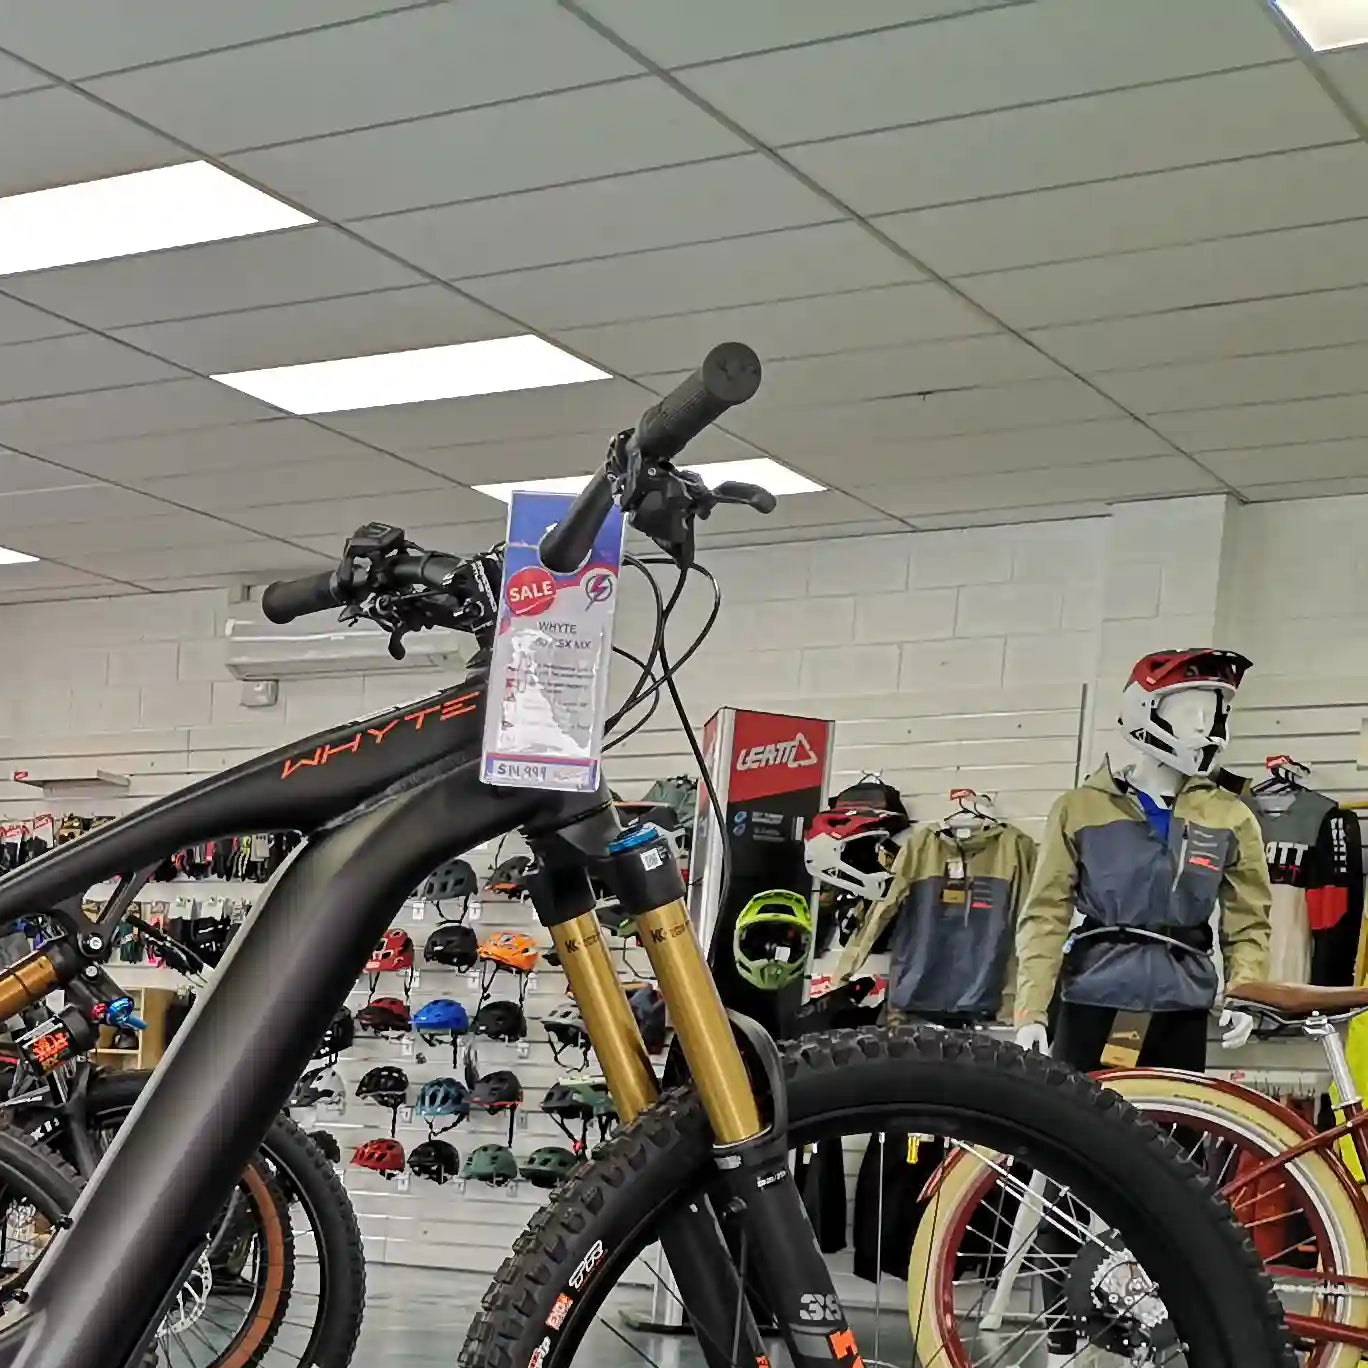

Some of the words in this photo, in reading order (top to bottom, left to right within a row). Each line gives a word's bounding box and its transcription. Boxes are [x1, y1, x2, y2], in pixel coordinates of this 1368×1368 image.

[509, 581, 553, 602] SALE
[538, 621, 577, 634] WHYTE
[281, 691, 481, 780] WHYTE
[736, 740, 798, 771] LEATT
